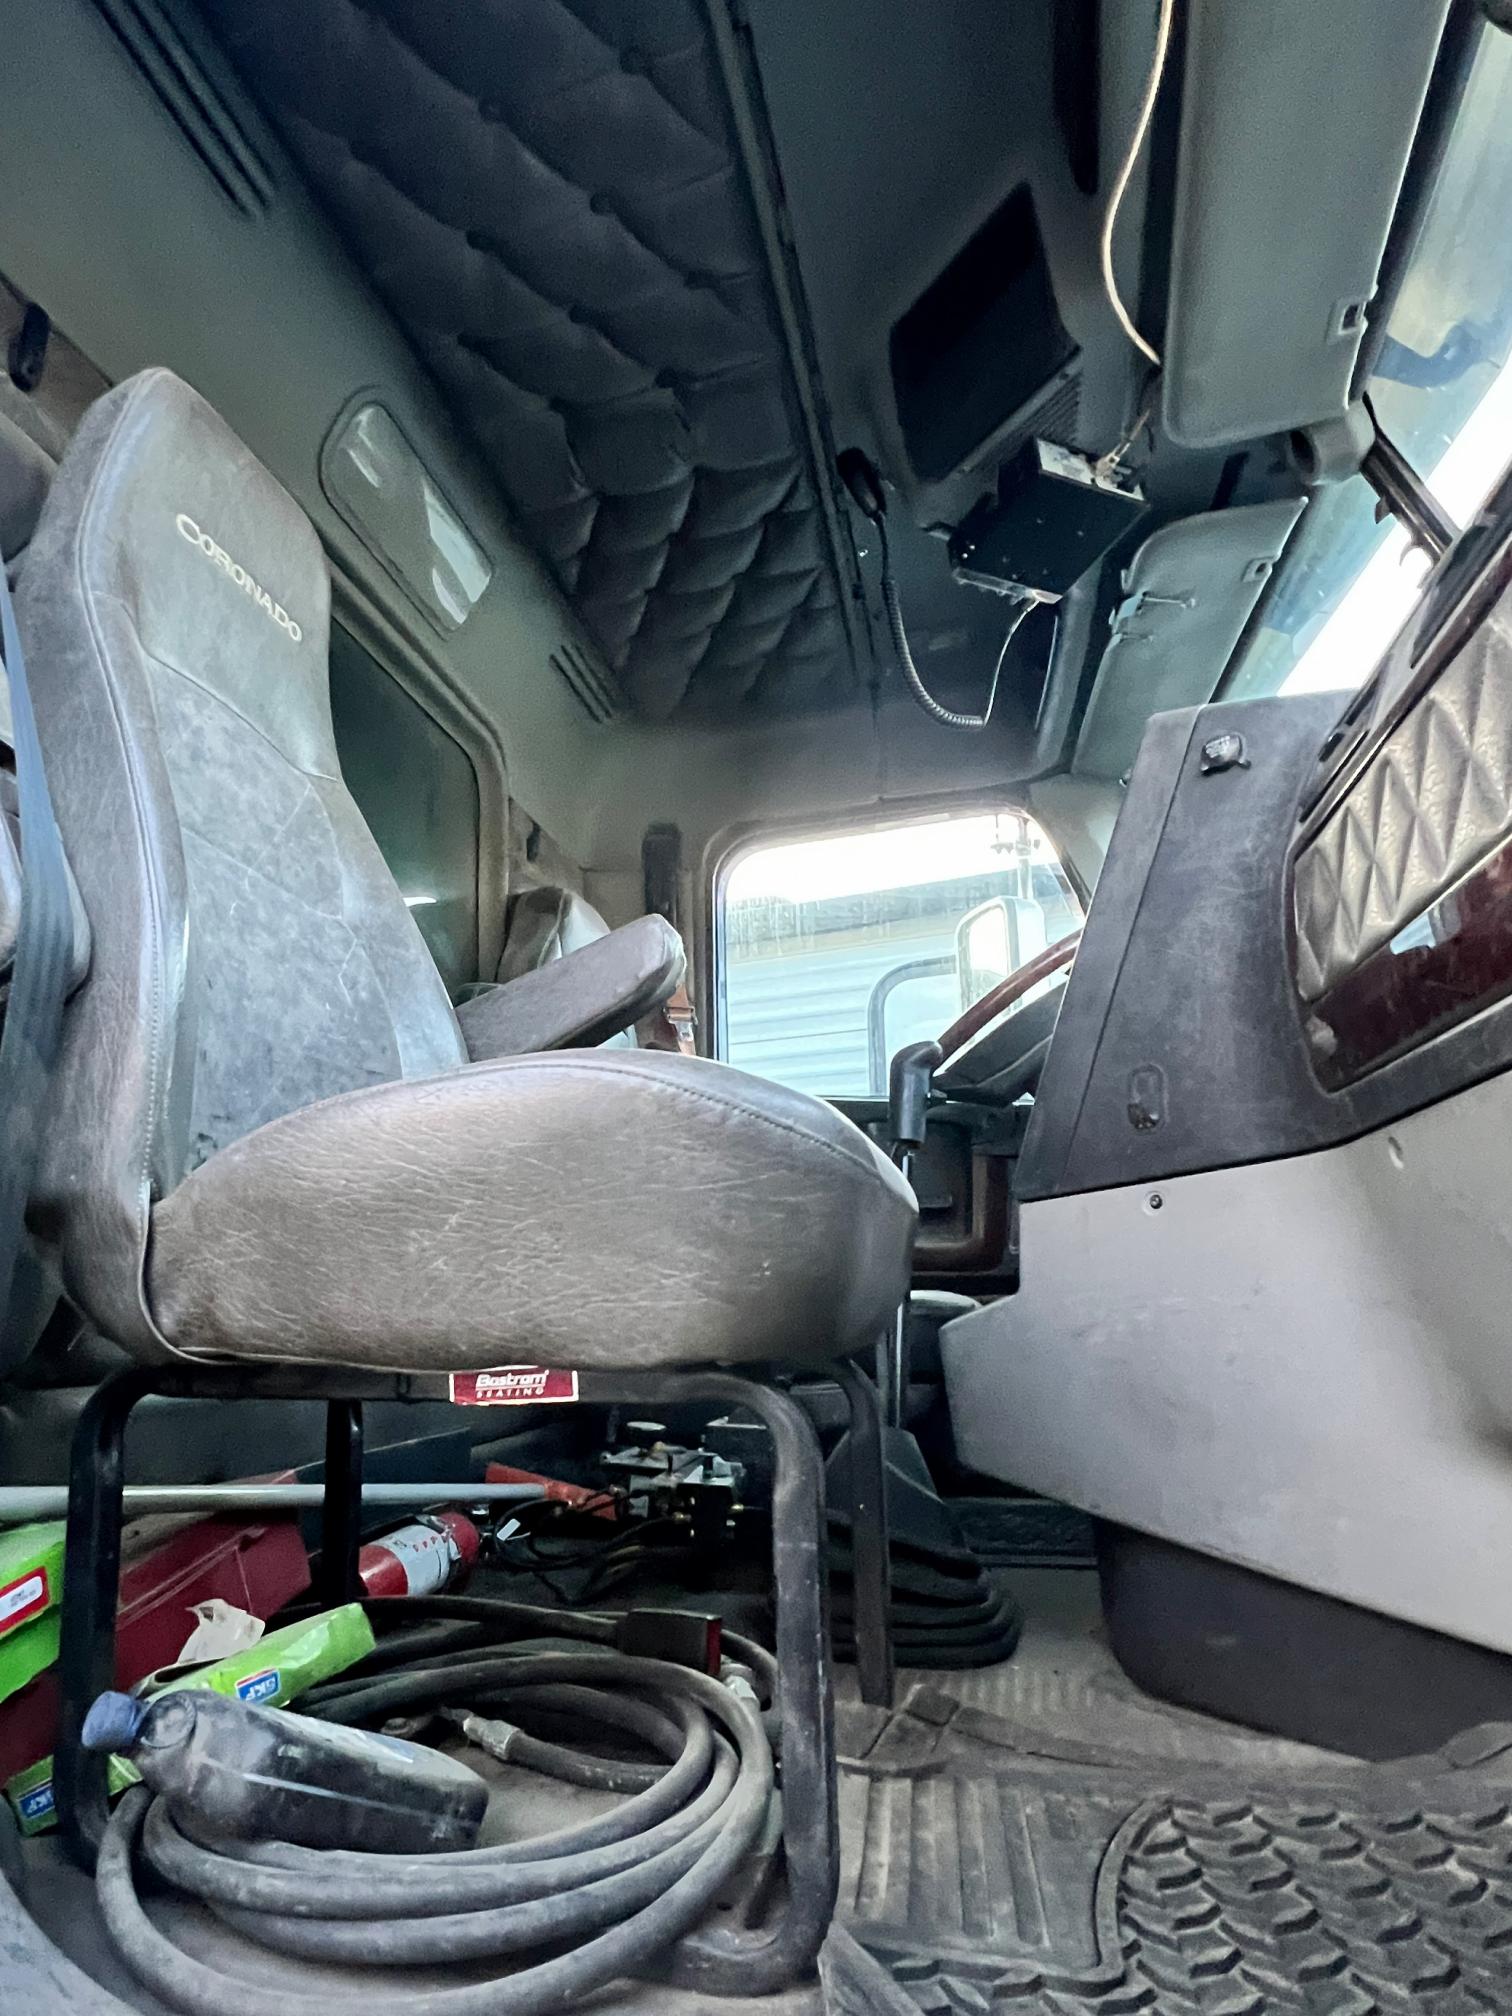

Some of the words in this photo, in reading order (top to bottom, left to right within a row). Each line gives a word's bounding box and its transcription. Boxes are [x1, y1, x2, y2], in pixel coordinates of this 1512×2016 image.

[176, 513, 302, 642] CORONADO
[476, 1387, 545, 1399] SEATING
[245, 1677, 276, 1701] SKF
